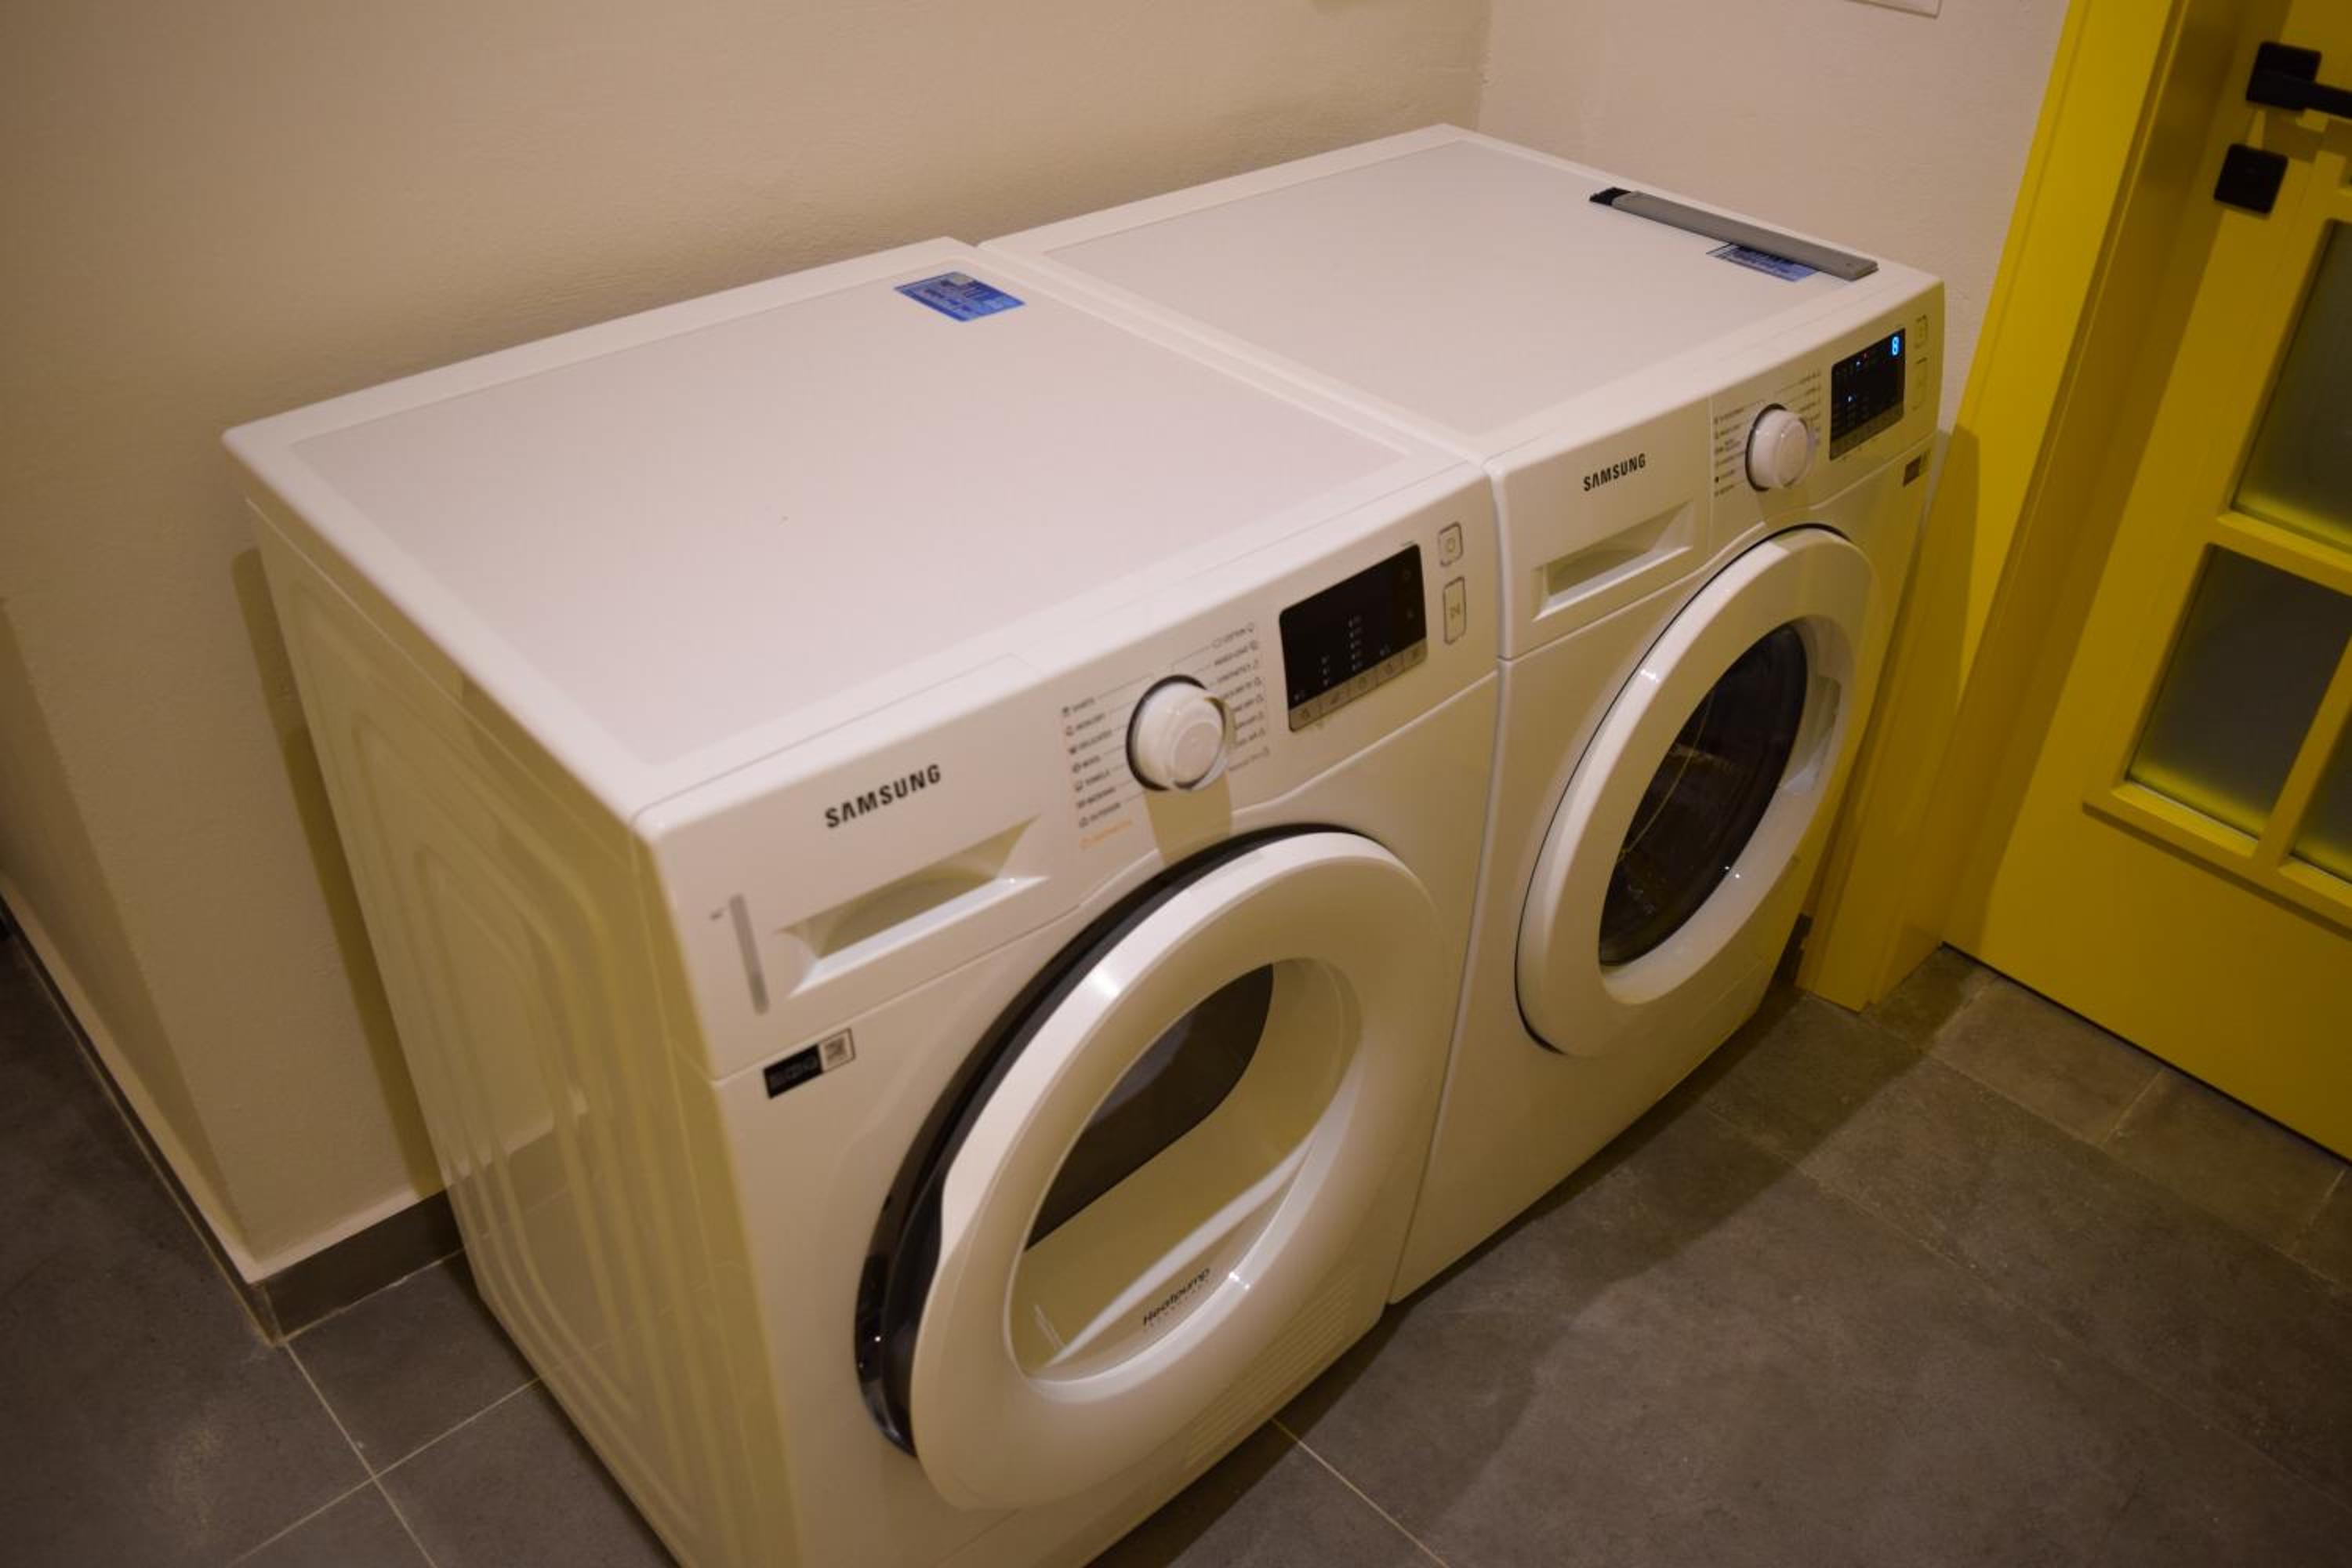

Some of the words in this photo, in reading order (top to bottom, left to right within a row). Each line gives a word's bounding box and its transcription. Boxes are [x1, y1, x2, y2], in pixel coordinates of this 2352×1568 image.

[1891, 336, 1900, 355] 8
[1583, 452, 1646, 492] SAMSUNG
[825, 764, 941, 829] SAMSUNG
